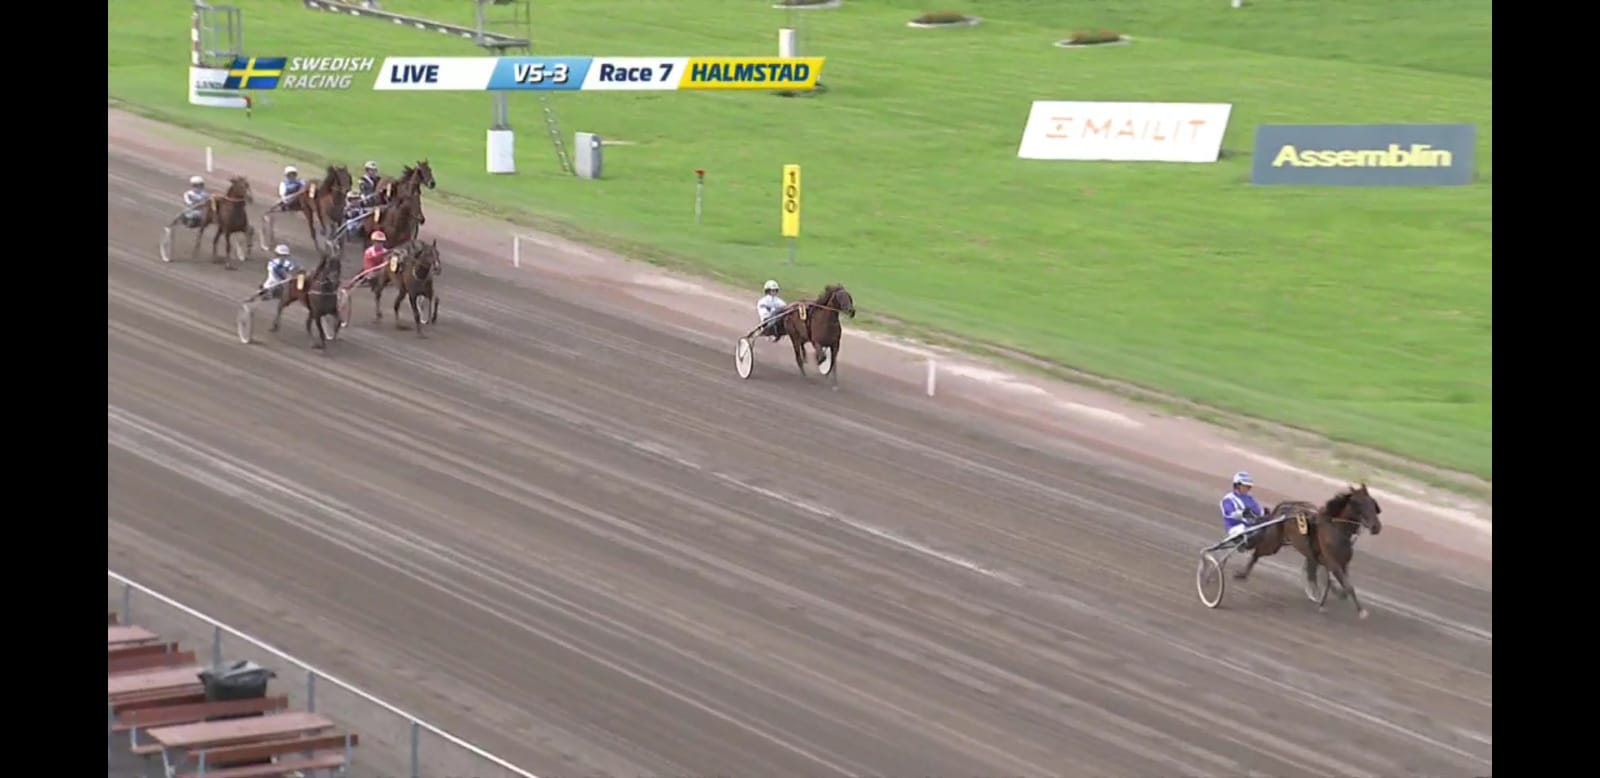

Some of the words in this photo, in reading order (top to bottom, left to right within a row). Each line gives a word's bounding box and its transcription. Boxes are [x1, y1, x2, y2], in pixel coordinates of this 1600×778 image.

[1082, 118, 1207, 140] MAILIT
[1272, 144, 1453, 168] Assemblin
[785, 170, 798, 214] 100
